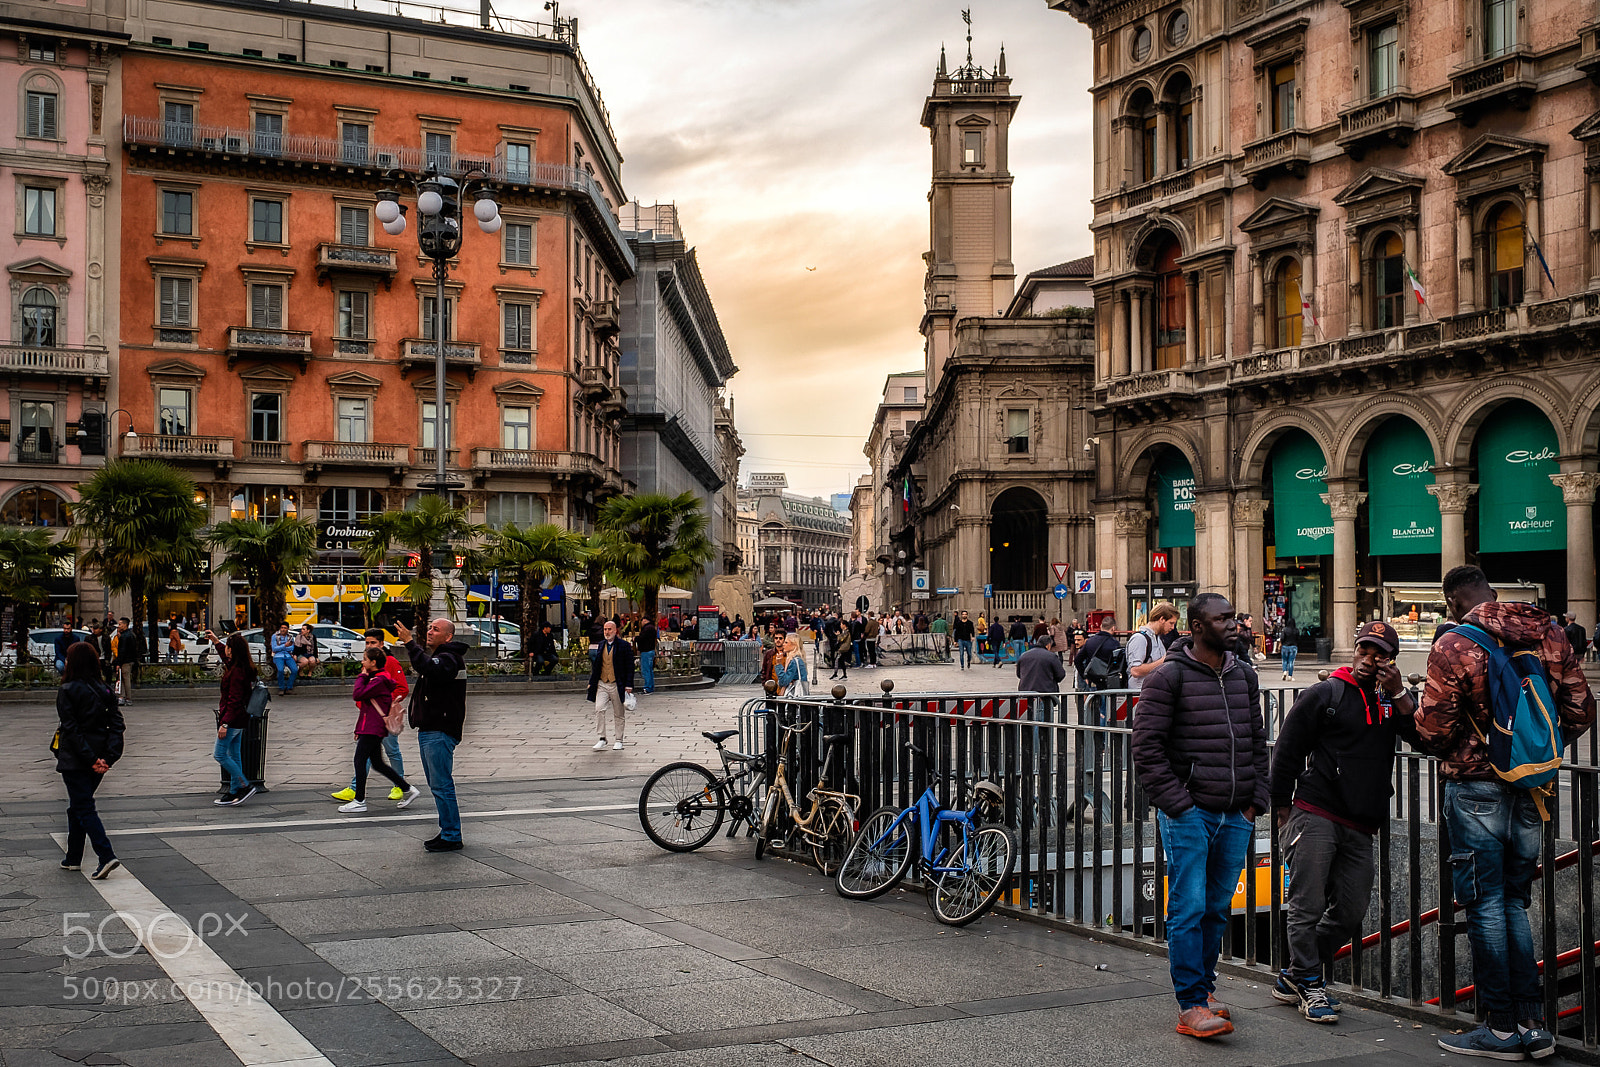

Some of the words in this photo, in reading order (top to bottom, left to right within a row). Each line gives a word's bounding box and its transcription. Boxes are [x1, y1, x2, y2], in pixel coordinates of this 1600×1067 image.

[1295, 465, 1329, 480] Ciel
[1172, 479, 1195, 487] BANCA
[326, 525, 380, 537] Orobianc
[1297, 526, 1335, 536] LONGINES
[1153, 555, 1166, 568] M
